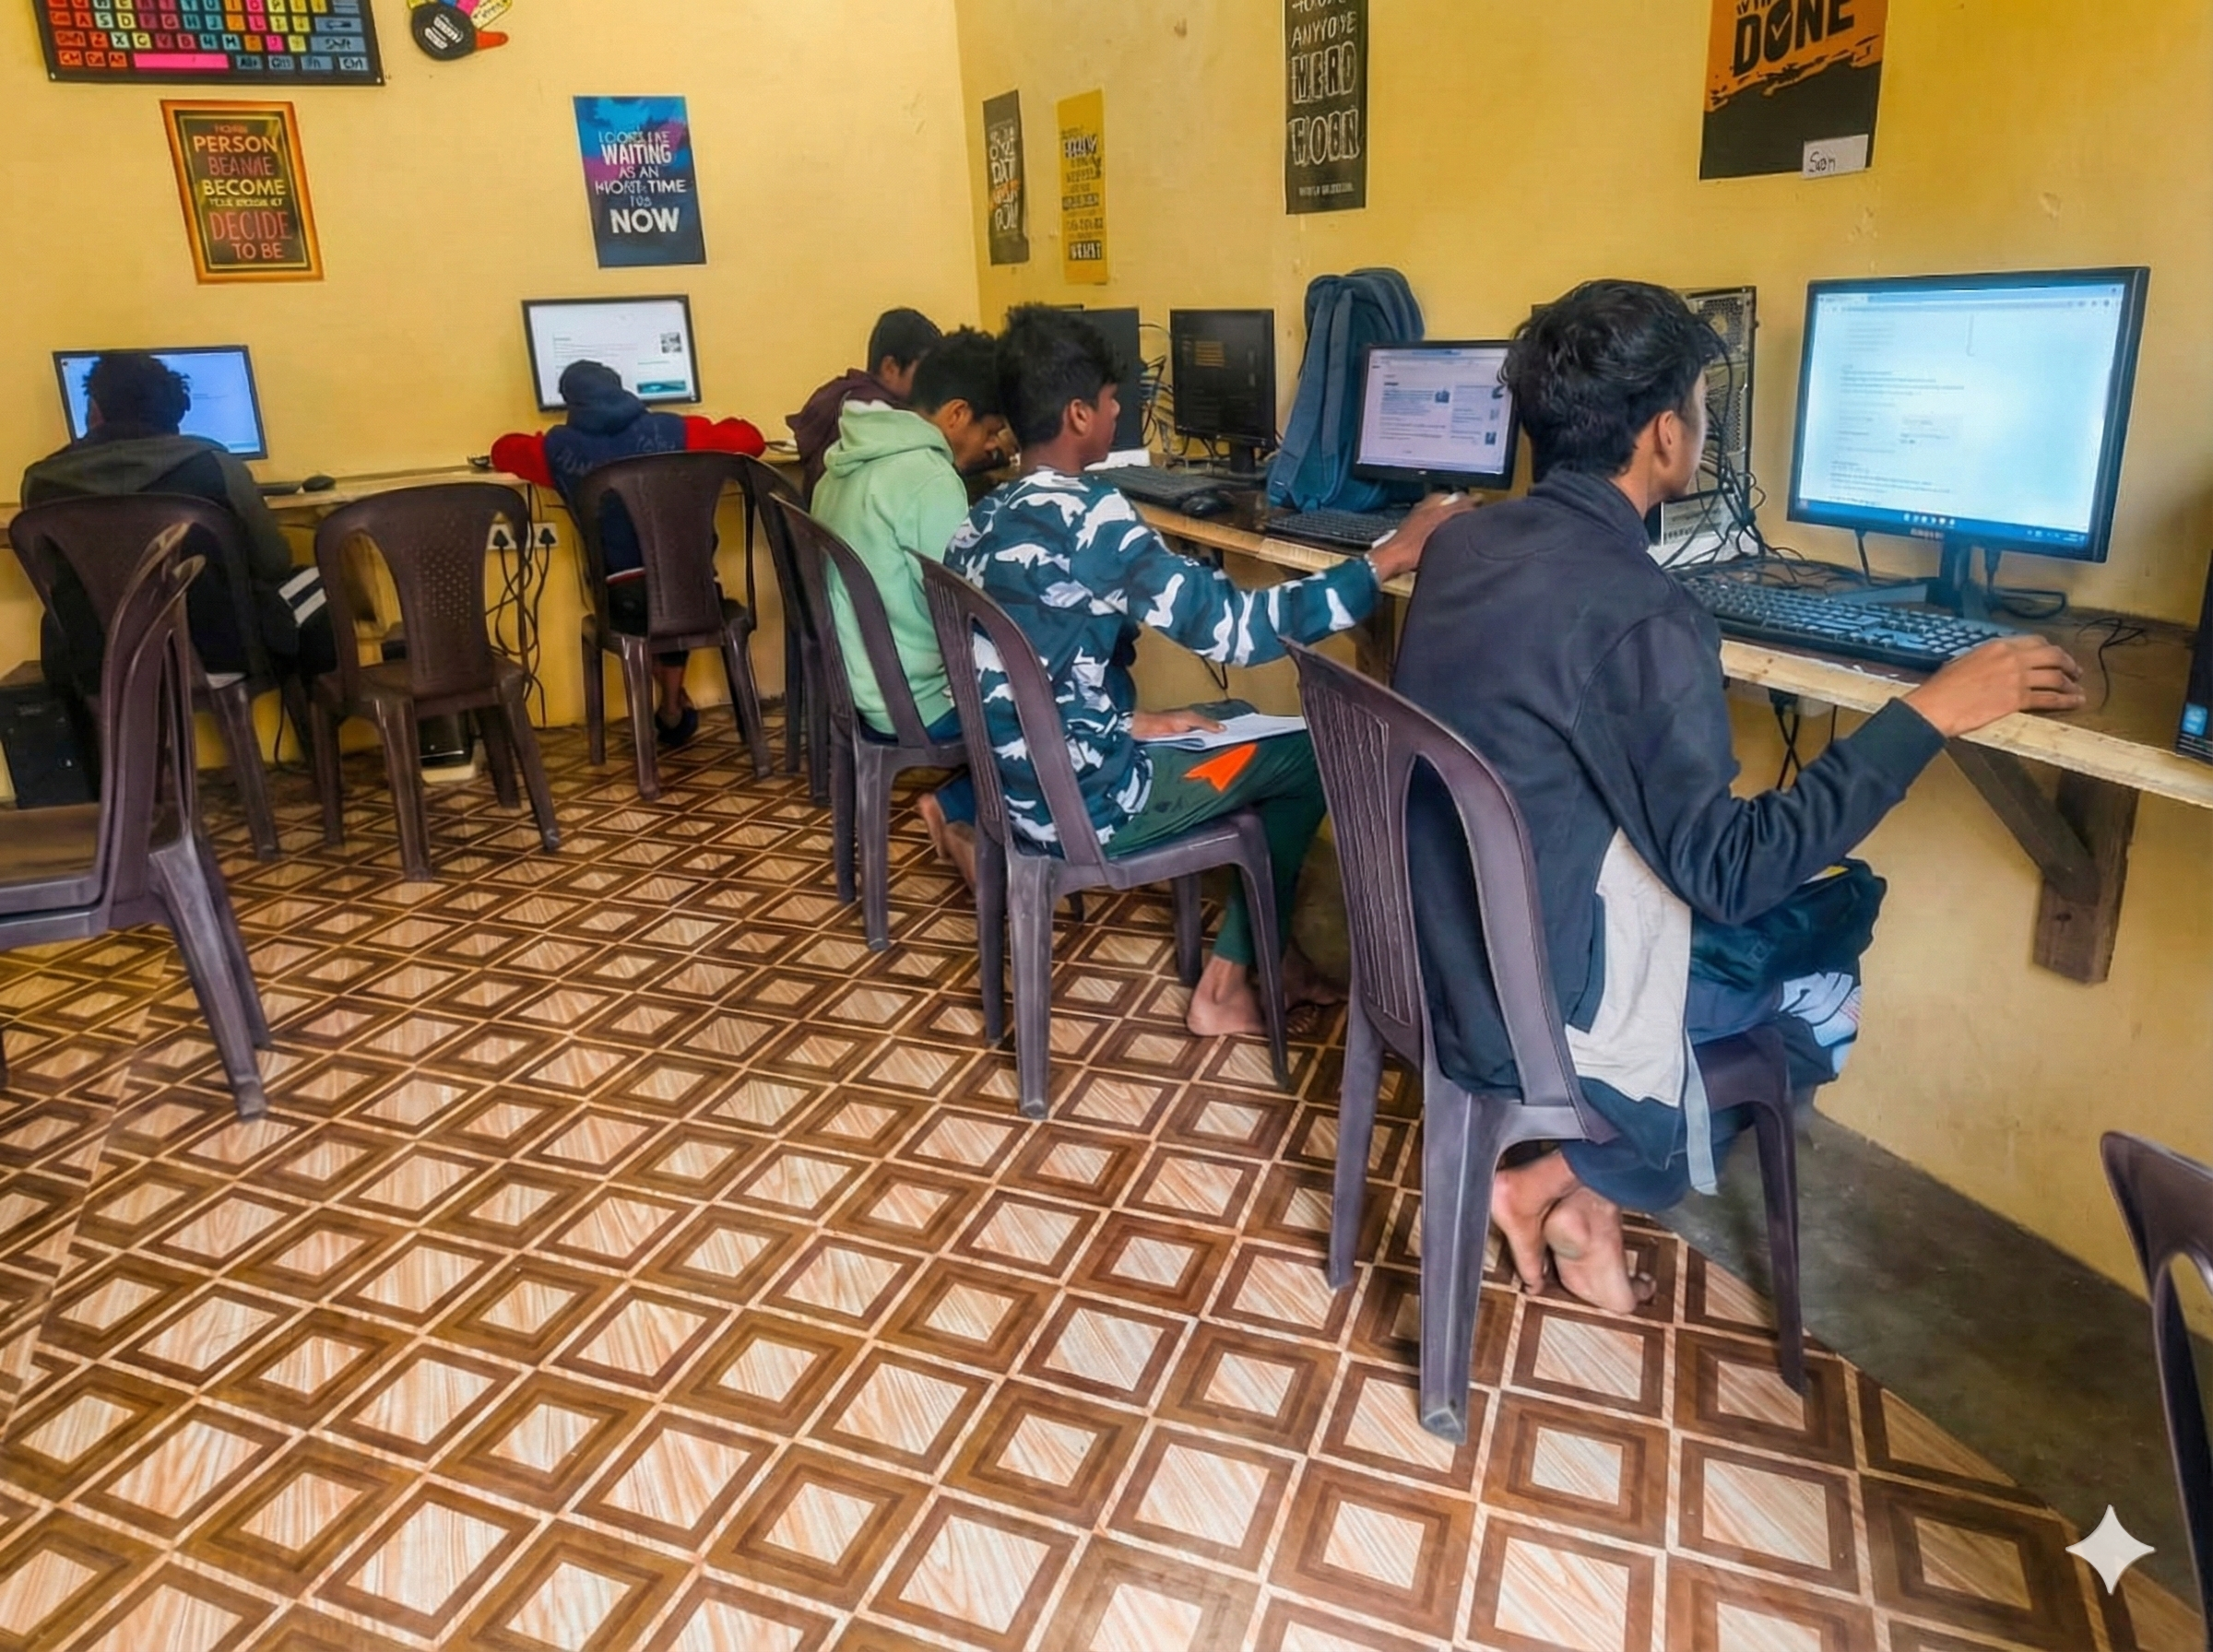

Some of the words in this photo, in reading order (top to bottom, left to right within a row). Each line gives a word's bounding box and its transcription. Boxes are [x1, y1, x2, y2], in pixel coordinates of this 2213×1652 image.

[113, 33, 126, 46] X
[1733, 0, 1854, 77] DONE
[193, 136, 278, 153] PERSON
[600, 143, 672, 166] WAITING
[618, 166, 636, 179] AS
[639, 166, 659, 179] AN
[202, 179, 287, 195] BECOME
[646, 179, 687, 194] TIME
[208, 211, 293, 241] DECIDE
[609, 206, 680, 233] NOW
[231, 242, 257, 260] TO
[261, 242, 285, 260] BE
